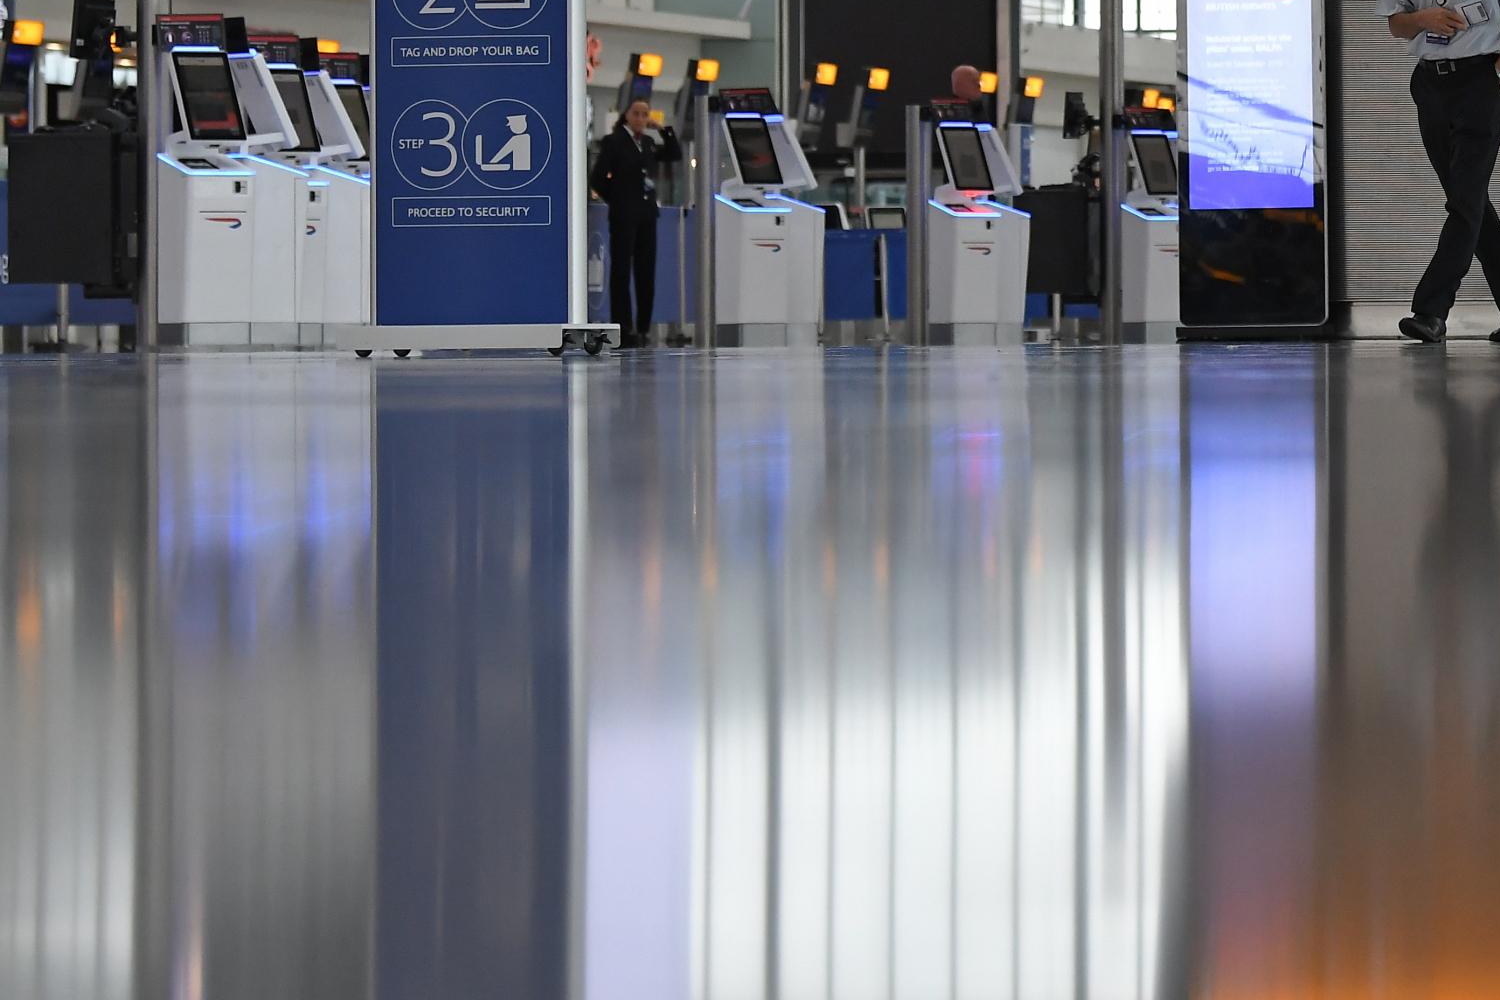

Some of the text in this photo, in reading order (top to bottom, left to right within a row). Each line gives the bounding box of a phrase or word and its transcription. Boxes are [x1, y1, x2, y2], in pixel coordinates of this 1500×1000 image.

[400, 45, 539, 57] TAG AND DROP YOUR BAG
[399, 111, 458, 177] STEP 3
[408, 206, 530, 218] PROCEED TO SECURITY
